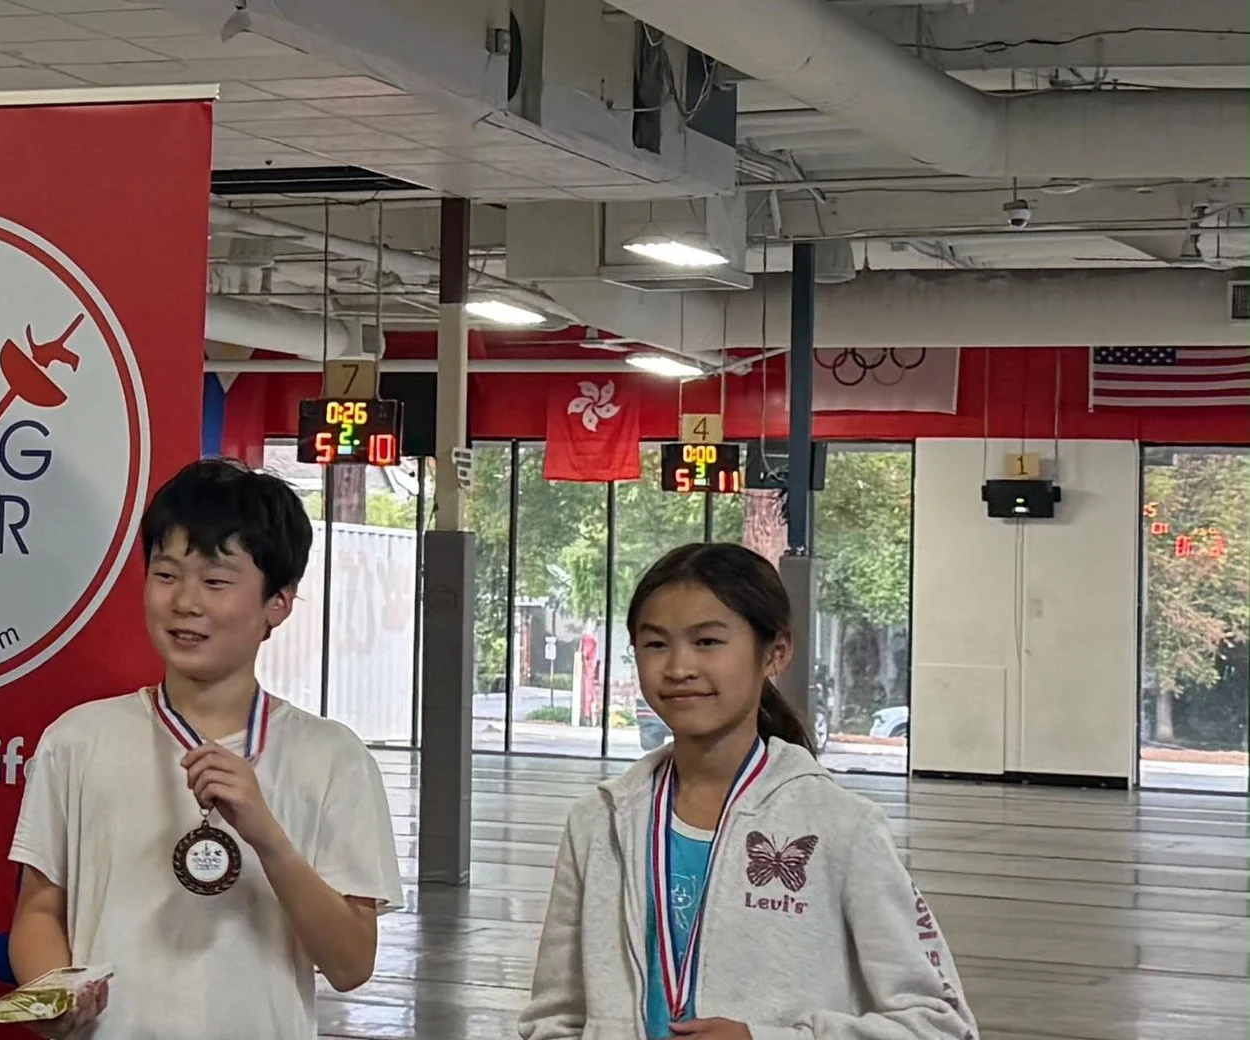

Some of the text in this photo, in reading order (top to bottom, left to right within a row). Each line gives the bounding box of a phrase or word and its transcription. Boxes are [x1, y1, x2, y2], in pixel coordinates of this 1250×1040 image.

[342, 364, 359, 395] 7
[326, 402, 368, 424] 0:26
[693, 417, 709, 441] 4
[315, 432, 395, 463] 5 10
[683, 445, 717, 463] 0:00
[1016, 455, 1027, 475] 1
[675, 468, 739, 492] 5 11
[745, 892, 809, 915] Levi's
